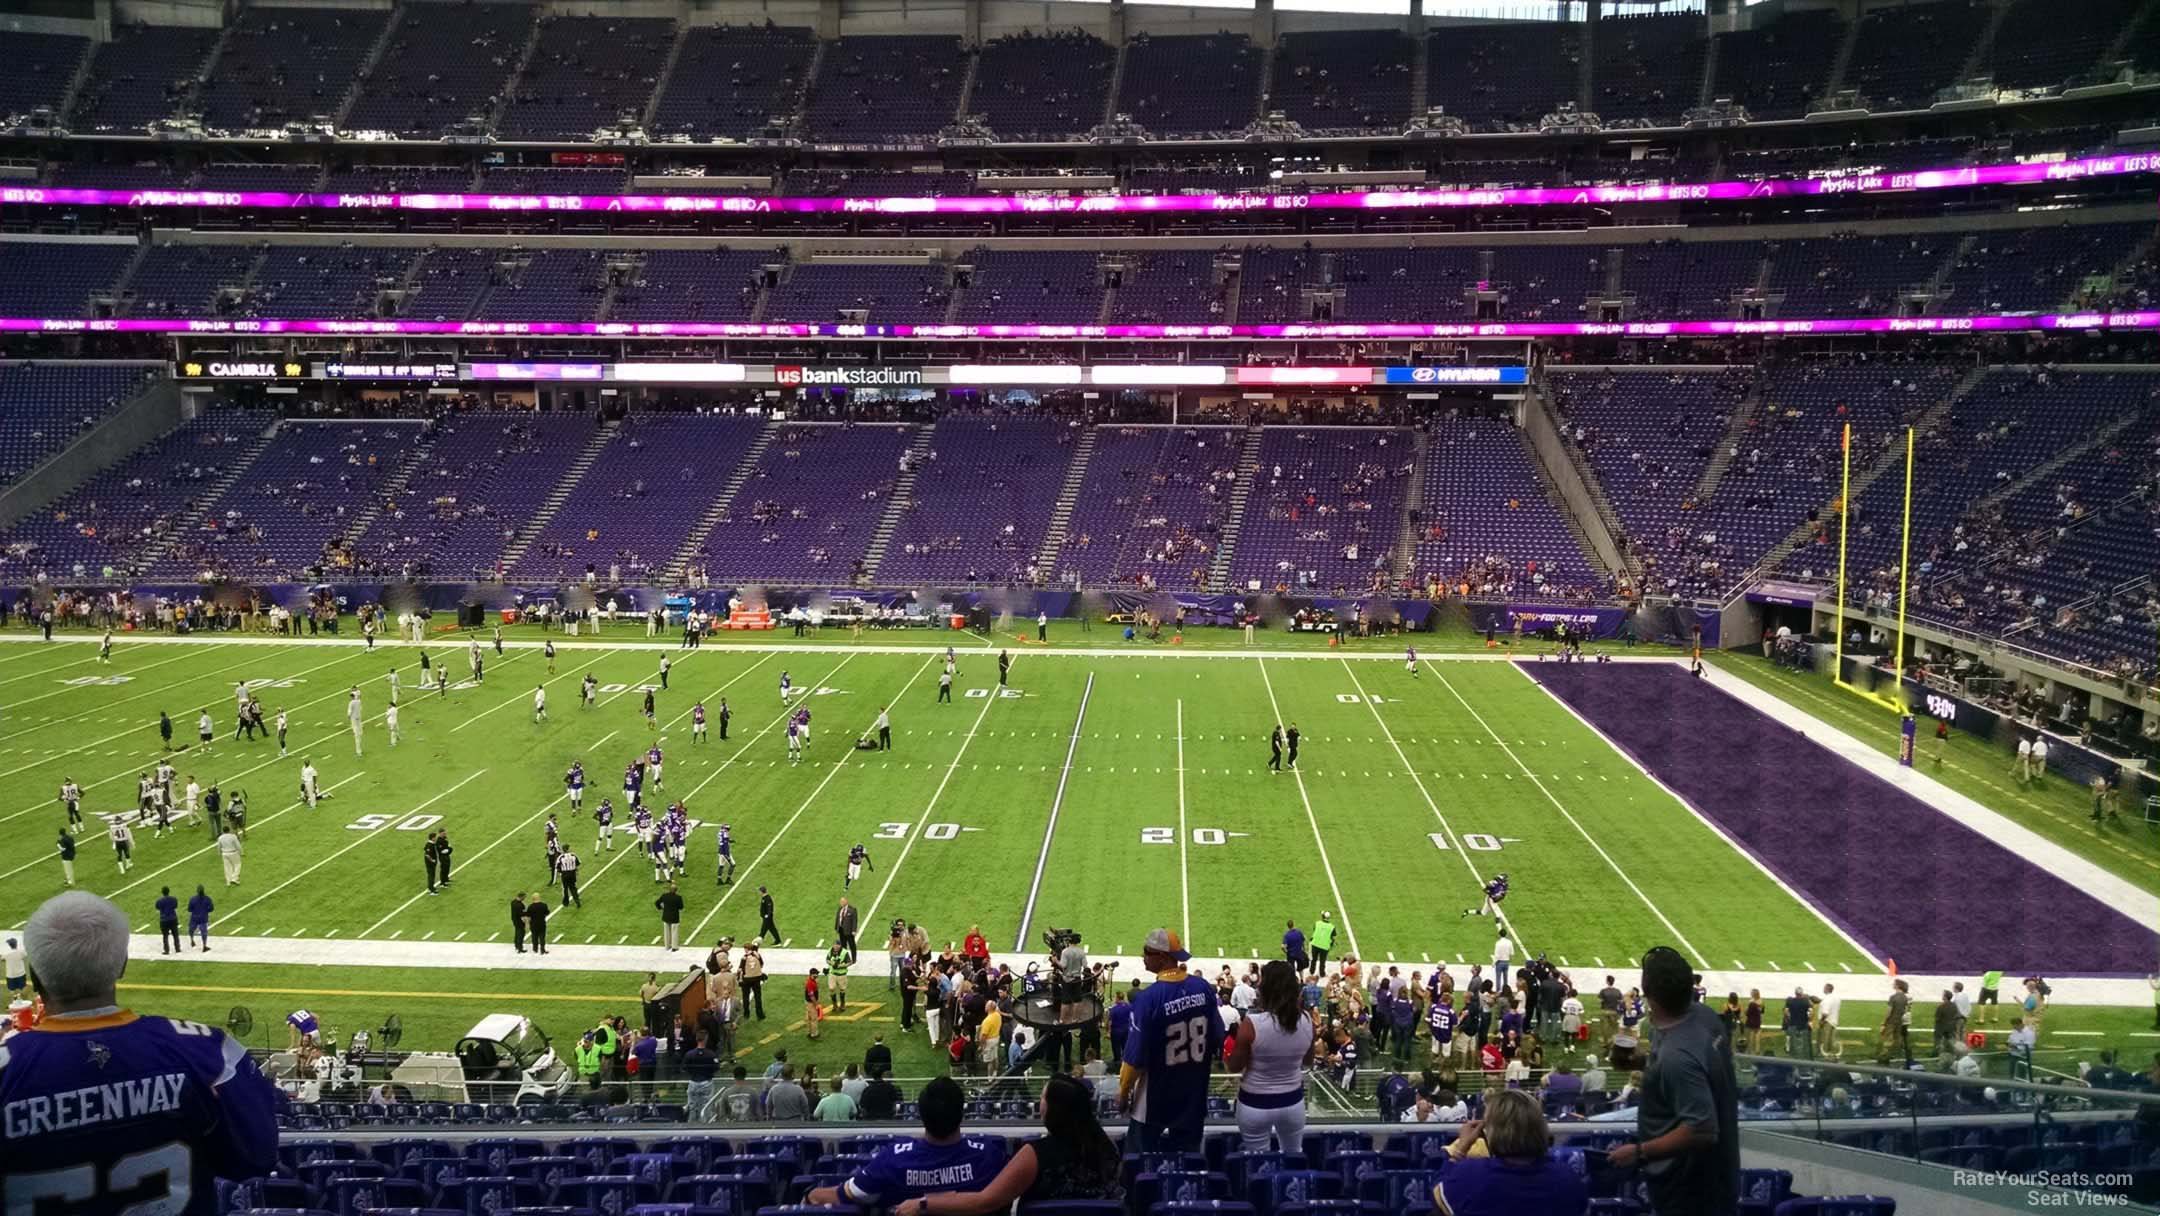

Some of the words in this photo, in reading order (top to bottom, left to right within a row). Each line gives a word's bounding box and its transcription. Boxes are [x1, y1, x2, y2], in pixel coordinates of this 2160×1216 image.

[209, 363, 277, 376] CAMBRIA
[1437, 369, 1500, 381] HYUNDAI
[344, 814, 444, 830] 50
[873, 822, 961, 840] 30
[1140, 827, 1227, 845] 20
[1427, 833, 1503, 850] 10
[1164, 993, 1206, 1016] PETERSON
[1432, 1013, 1450, 1029] 52
[1165, 1016, 1208, 1067] 28
[4, 1072, 186, 1139] GREENWAY
[906, 1163, 974, 1186] BRIDGEWATER
